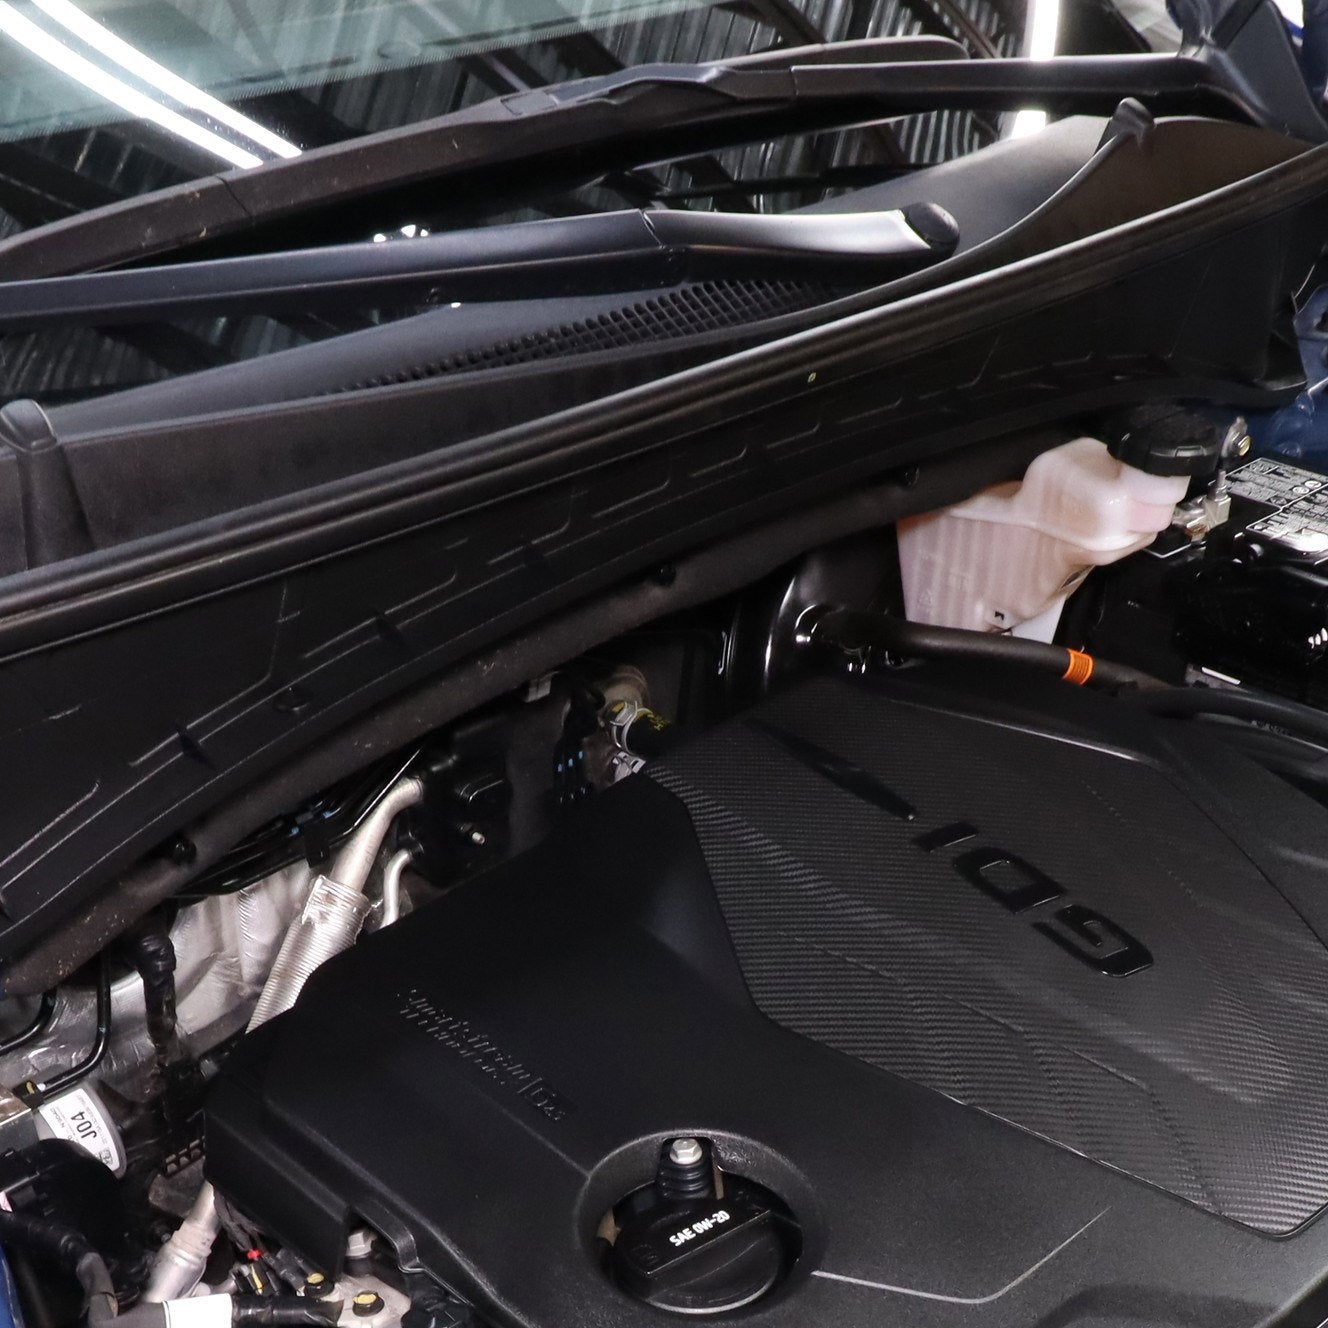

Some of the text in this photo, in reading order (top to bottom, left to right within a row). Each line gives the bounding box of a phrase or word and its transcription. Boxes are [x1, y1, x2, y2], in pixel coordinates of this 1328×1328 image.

[70, 1110, 98, 1139] J04
[669, 1210, 731, 1246] SAE 0W-20
